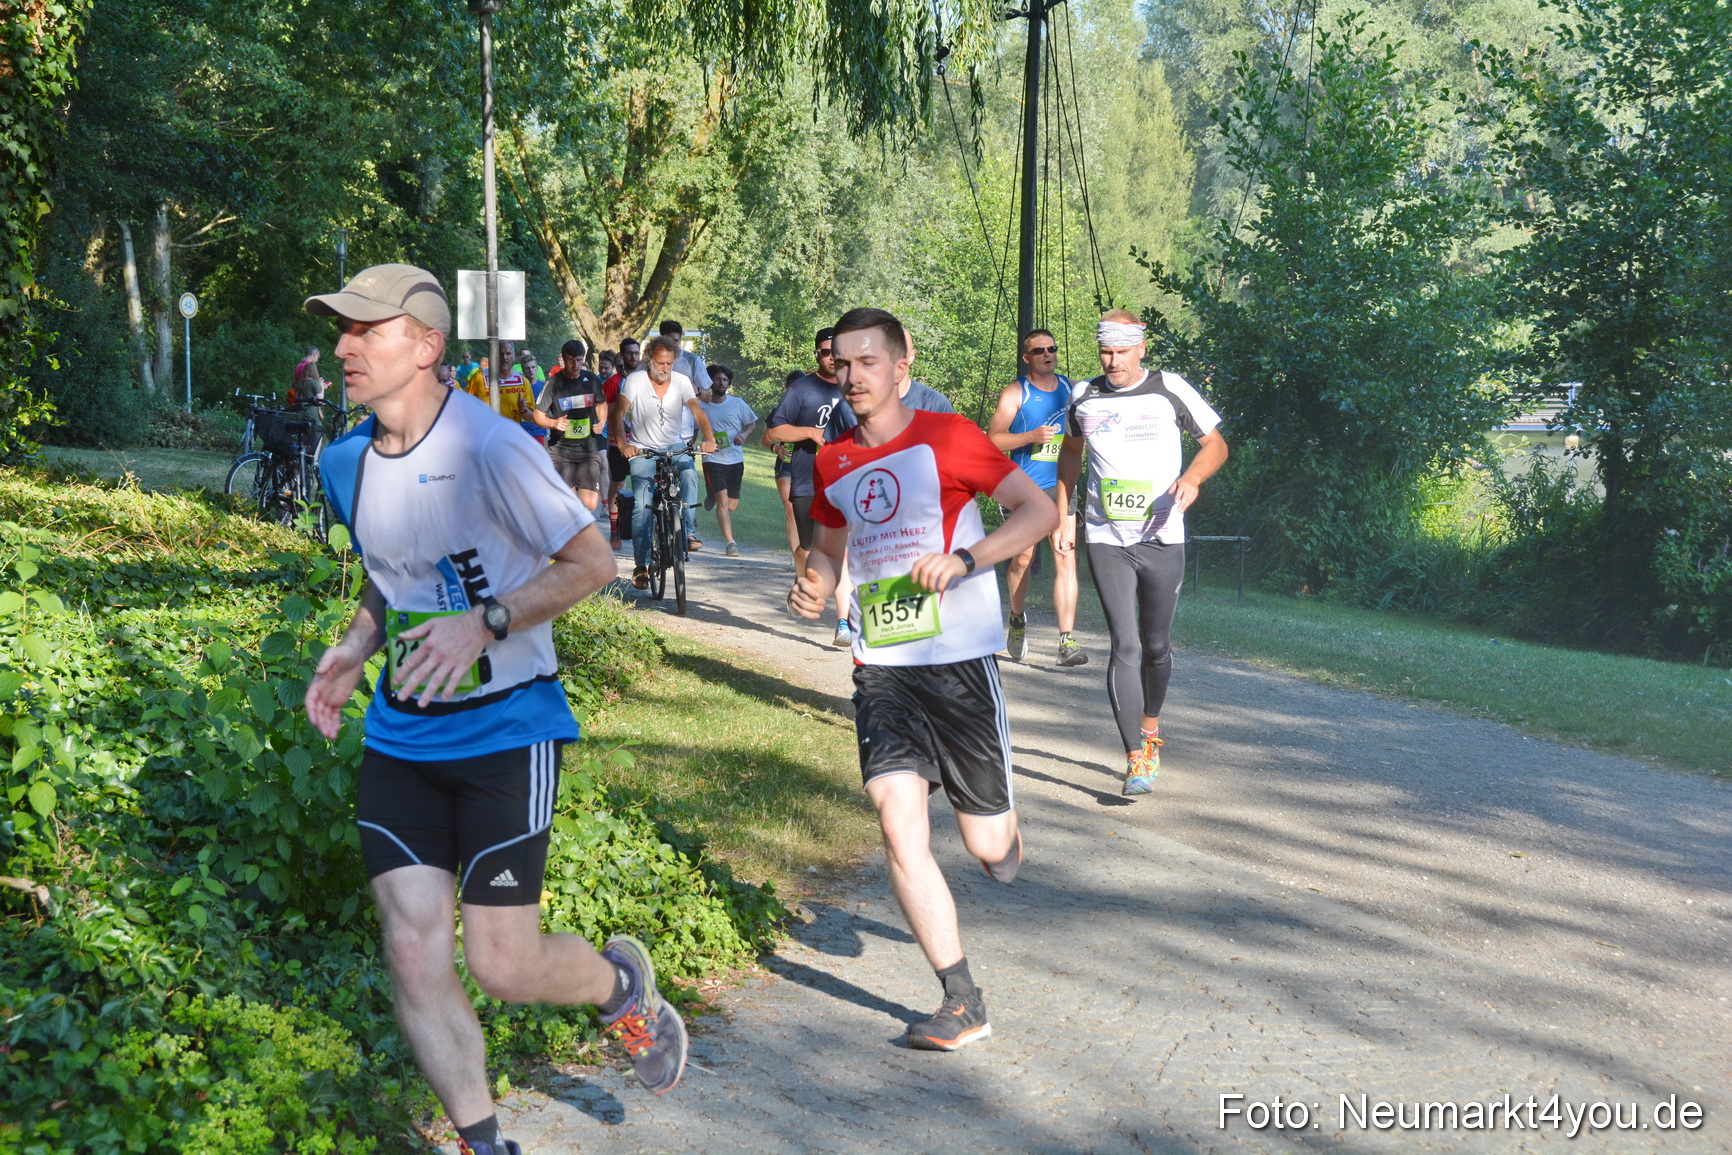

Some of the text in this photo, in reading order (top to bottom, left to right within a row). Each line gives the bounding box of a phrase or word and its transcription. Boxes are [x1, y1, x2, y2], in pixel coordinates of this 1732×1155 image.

[572, 425, 583, 434] 52
[1106, 492, 1146, 509] 1462
[869, 595, 924, 627] 1557
